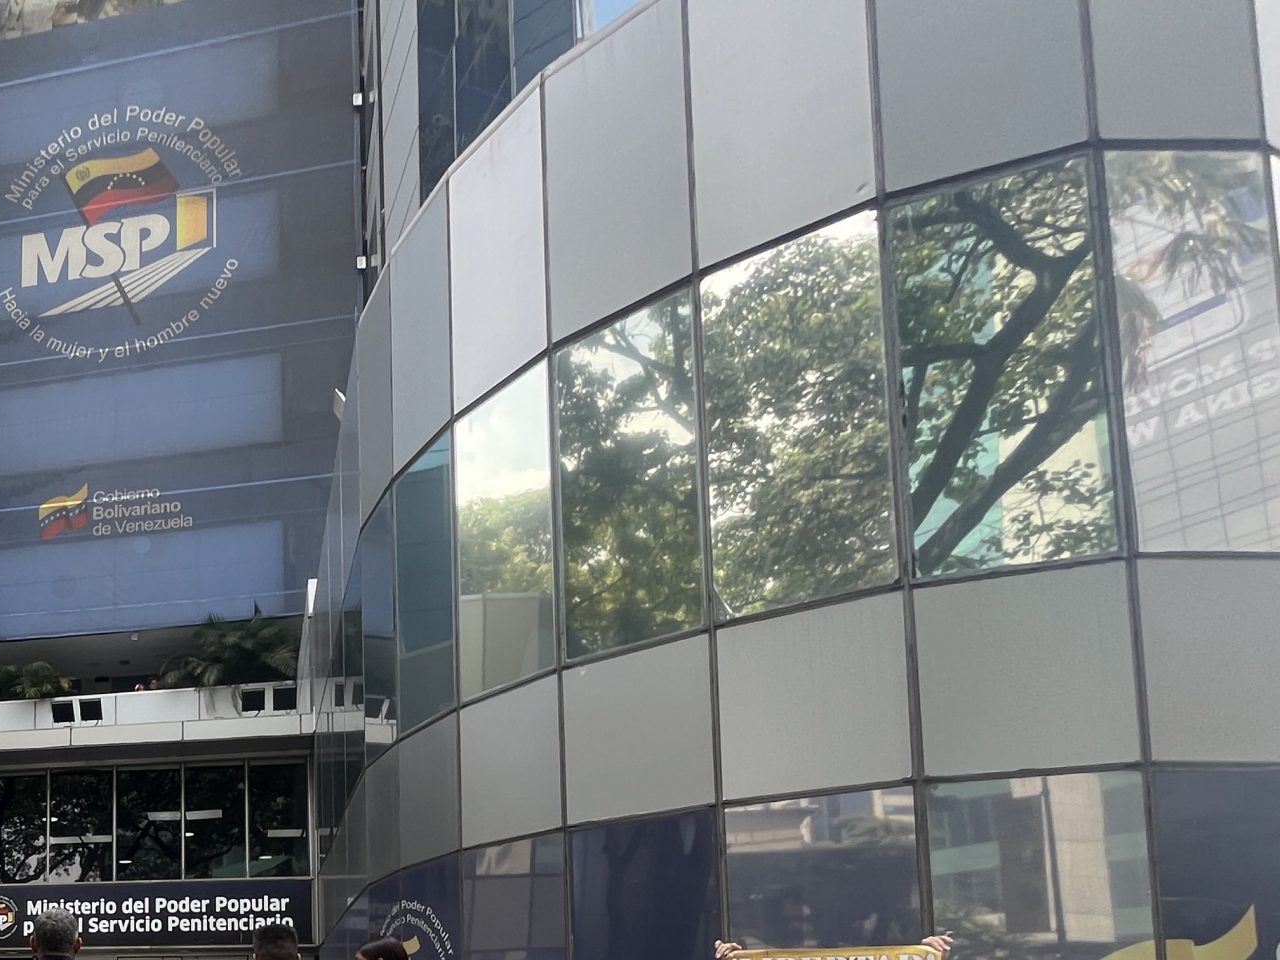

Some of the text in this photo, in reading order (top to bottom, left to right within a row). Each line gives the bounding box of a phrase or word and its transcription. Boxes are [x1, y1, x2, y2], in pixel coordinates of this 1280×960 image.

[5, 105, 242, 203] Ministerio del Poder Popular
[22, 127, 223, 210] para el Servicio Penitenciario
[21, 213, 170, 288] MSP
[0, 258, 238, 363] Hacia la mujer y el hombre nuevo
[93, 487, 160, 504] Gobierno
[93, 501, 181, 520] Bolivariano
[93, 514, 193, 537] de Venezuela
[88, 916, 163, 933] Servicio
[122, 897, 149, 914] del
[156, 896, 210, 914] Poder
[216, 895, 290, 915] Popular
[401, 899, 426, 913] Poder
[426, 907, 454, 956] Popular
